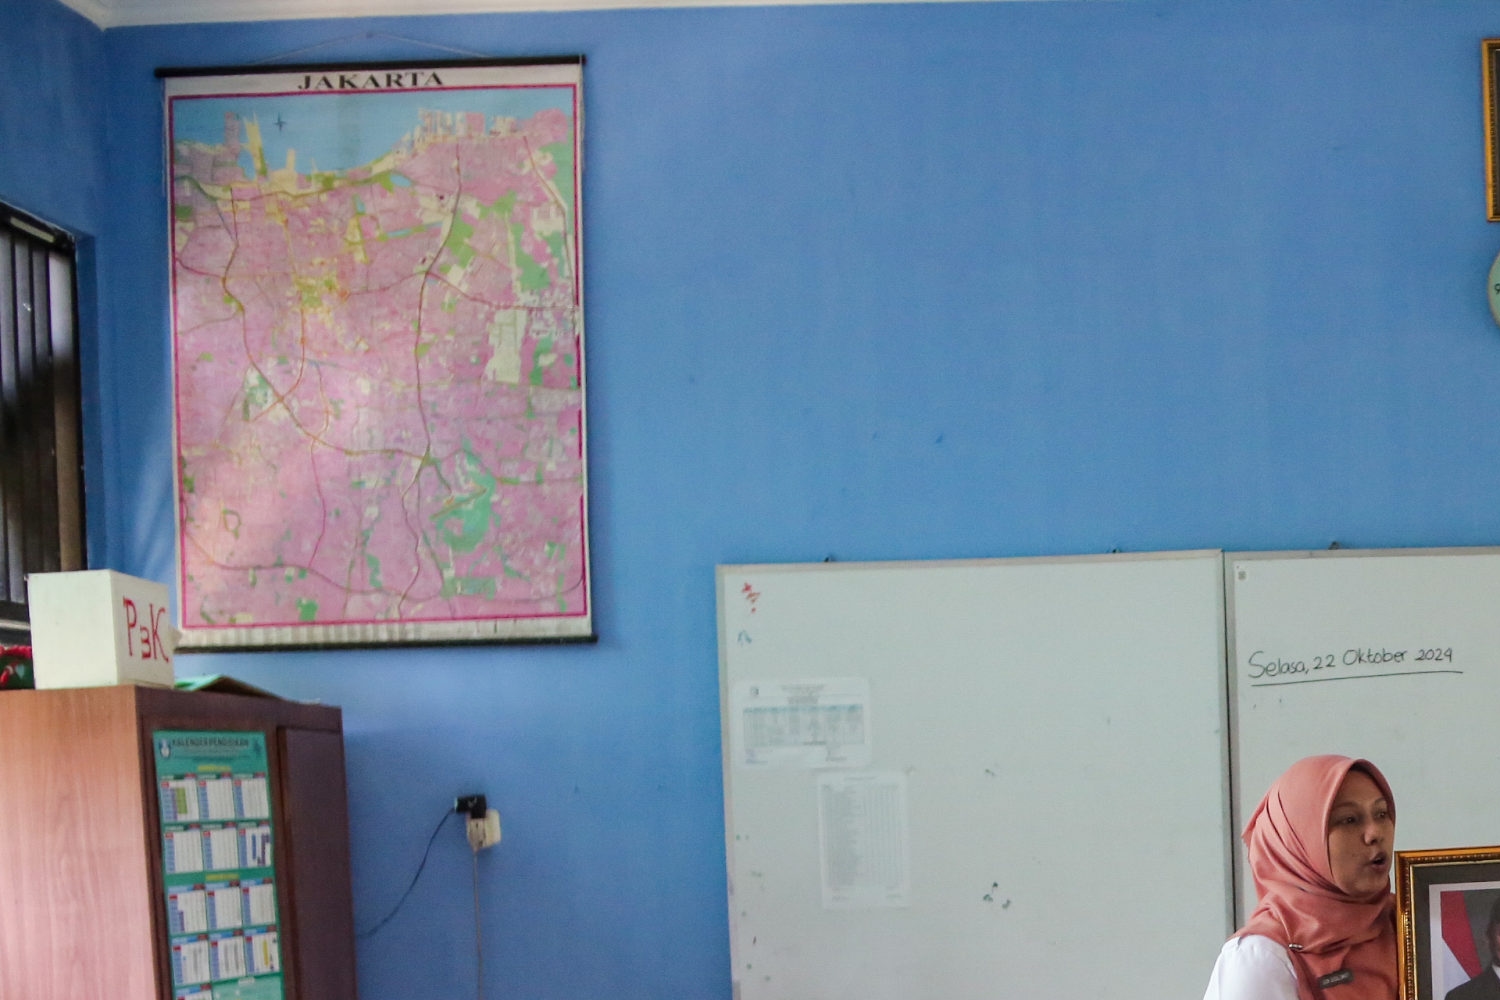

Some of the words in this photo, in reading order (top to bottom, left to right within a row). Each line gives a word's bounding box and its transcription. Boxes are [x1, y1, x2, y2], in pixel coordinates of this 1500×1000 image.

[297, 71, 443, 90] JAKARTA
[122, 596, 169, 663] P3K
[1313, 654, 1336, 670] 22
[1342, 648, 1407, 666] Oktober
[1415, 647, 1453, 663] 2024
